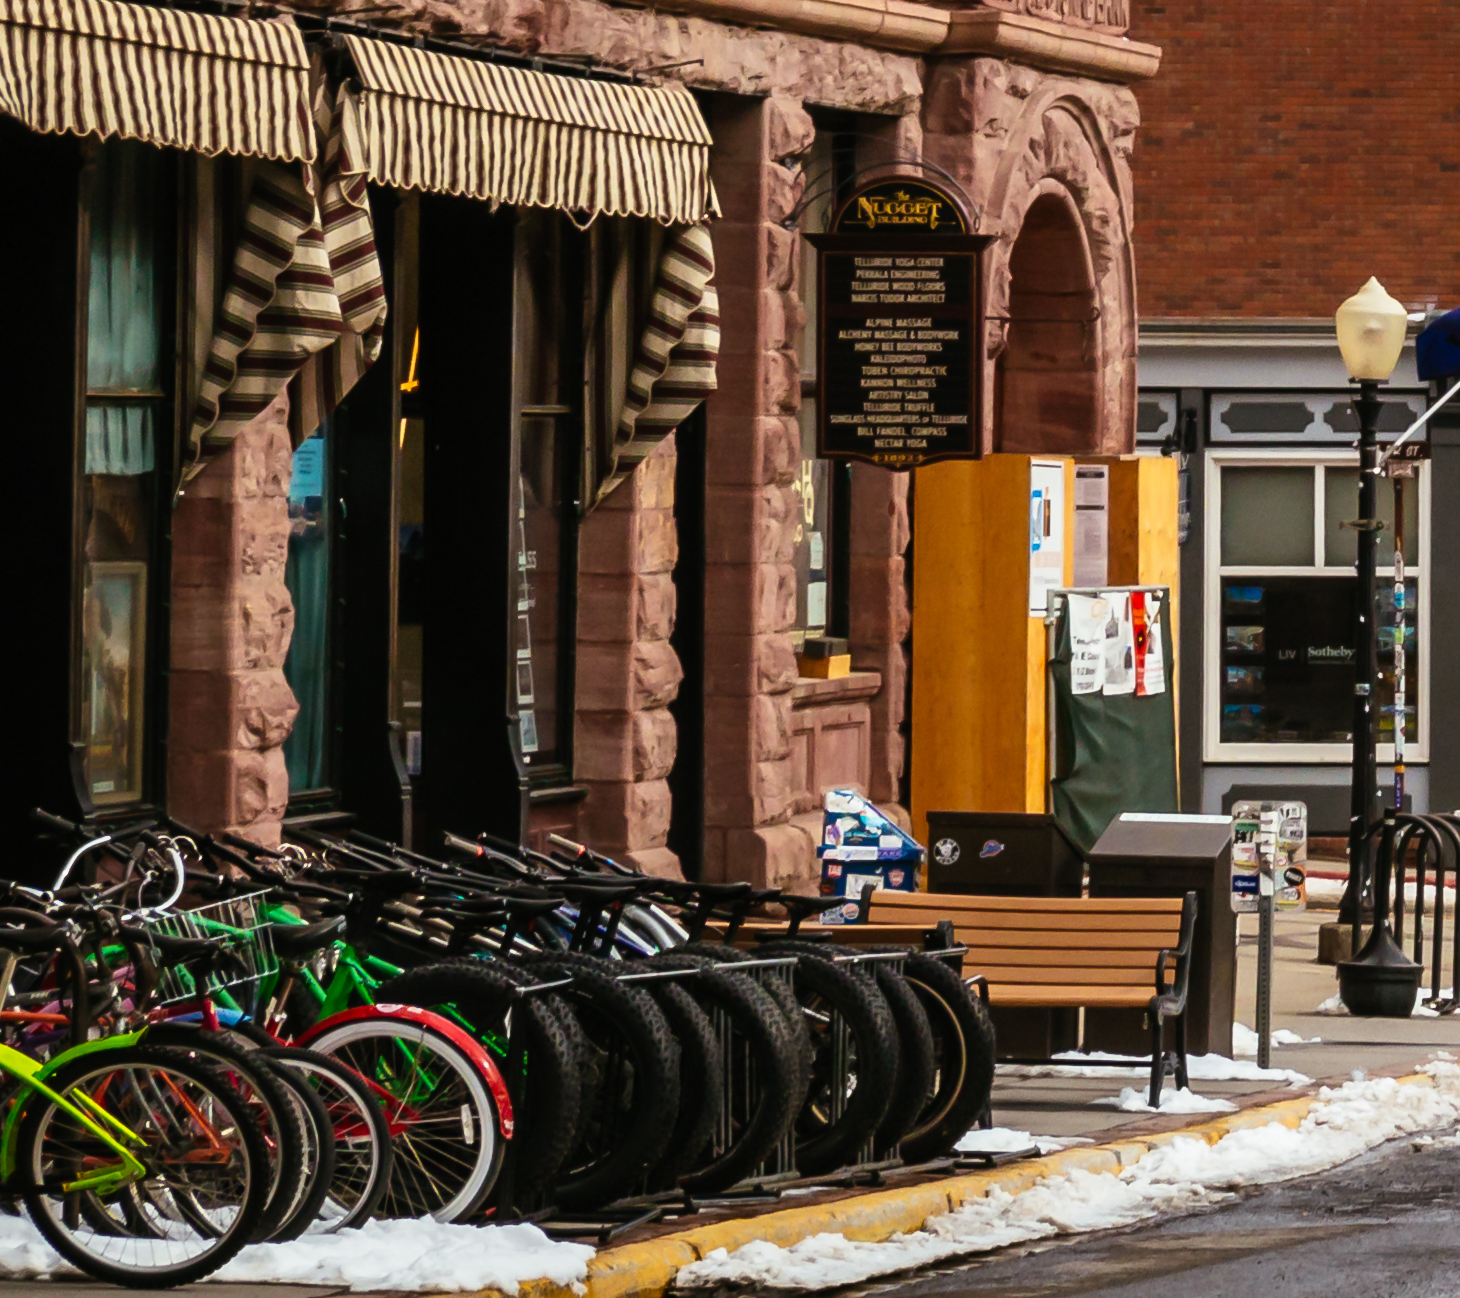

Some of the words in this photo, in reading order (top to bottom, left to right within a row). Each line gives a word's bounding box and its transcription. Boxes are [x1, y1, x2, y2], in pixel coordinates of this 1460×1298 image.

[857, 196, 943, 229] NUGGET
[876, 216, 928, 224] BUILDING
[1278, 649, 1297, 660] LIV
[1308, 645, 1356, 660] Sotheby
